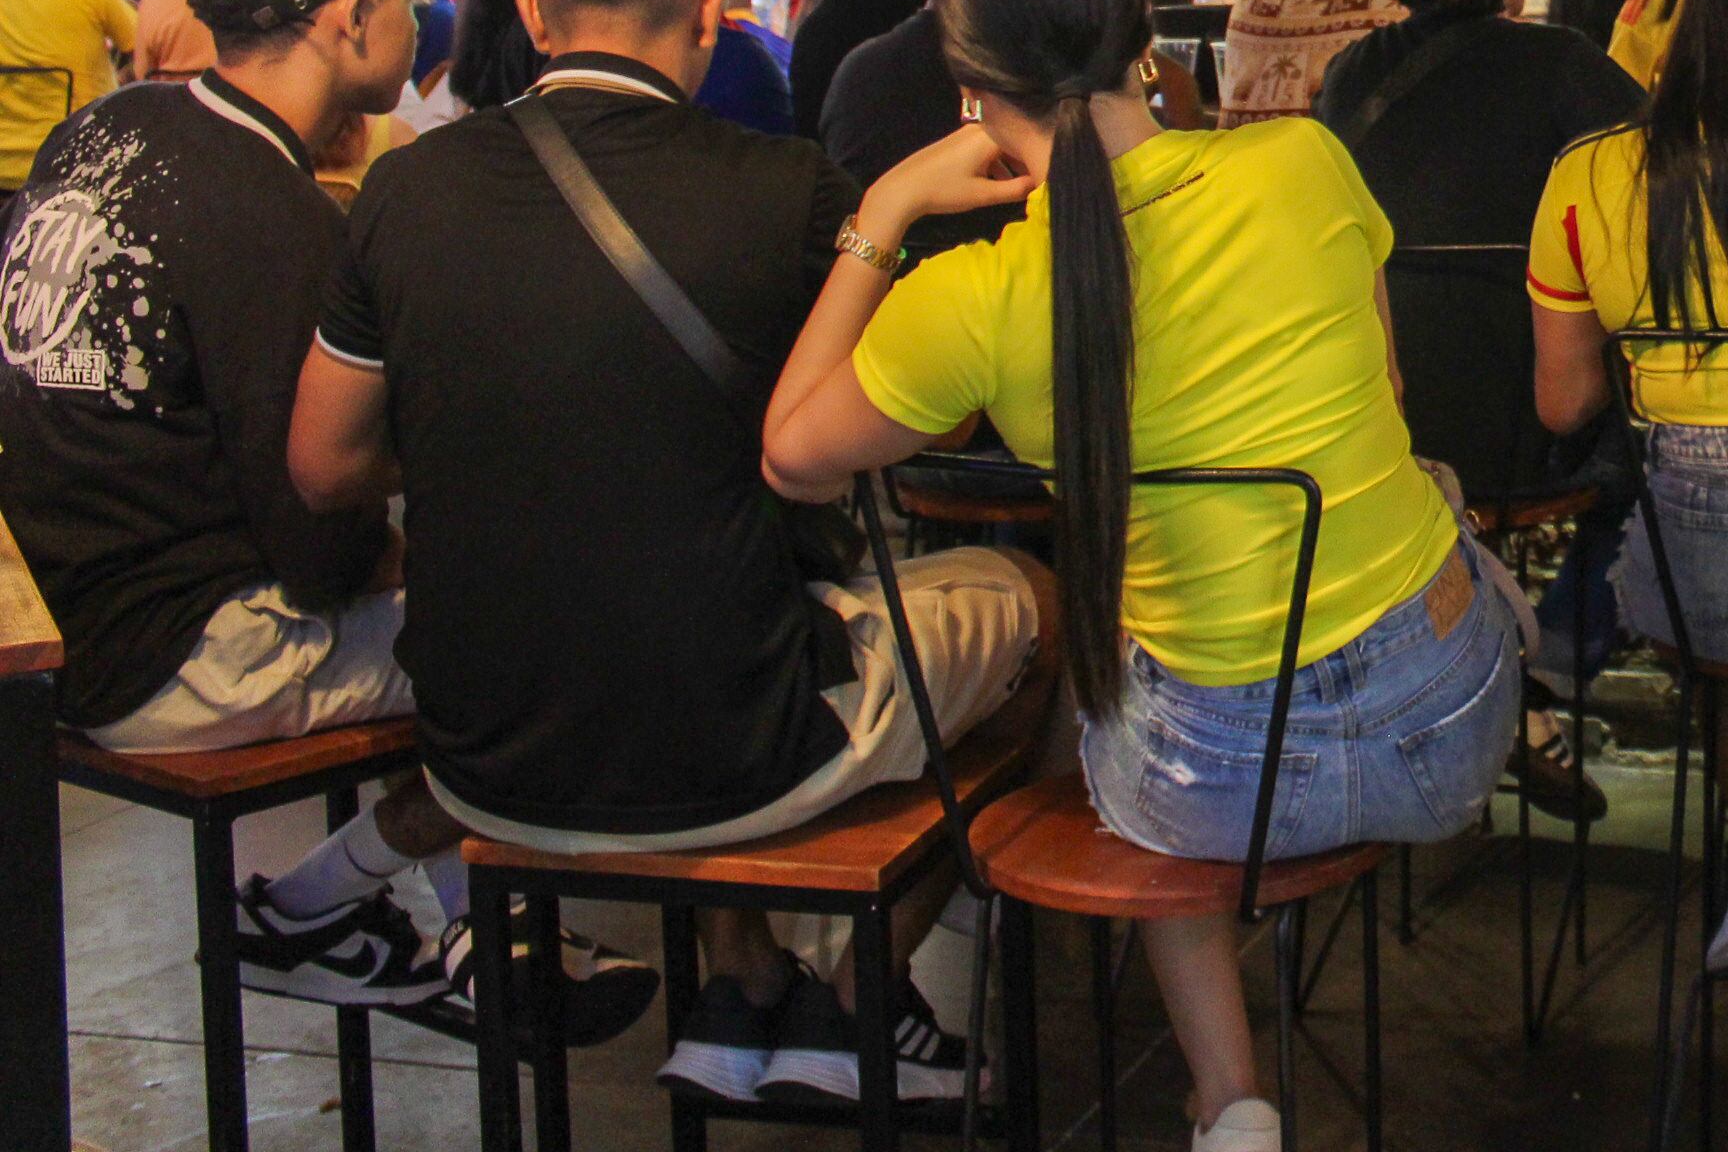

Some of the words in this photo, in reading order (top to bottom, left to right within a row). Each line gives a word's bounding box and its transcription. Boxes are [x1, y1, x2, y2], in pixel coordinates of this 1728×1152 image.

[10, 210, 109, 275] STAY
[2, 269, 70, 339] FUN
[39, 367, 102, 385] STARTED
[40, 351, 61, 369] WE
[64, 350, 103, 369] JUST
